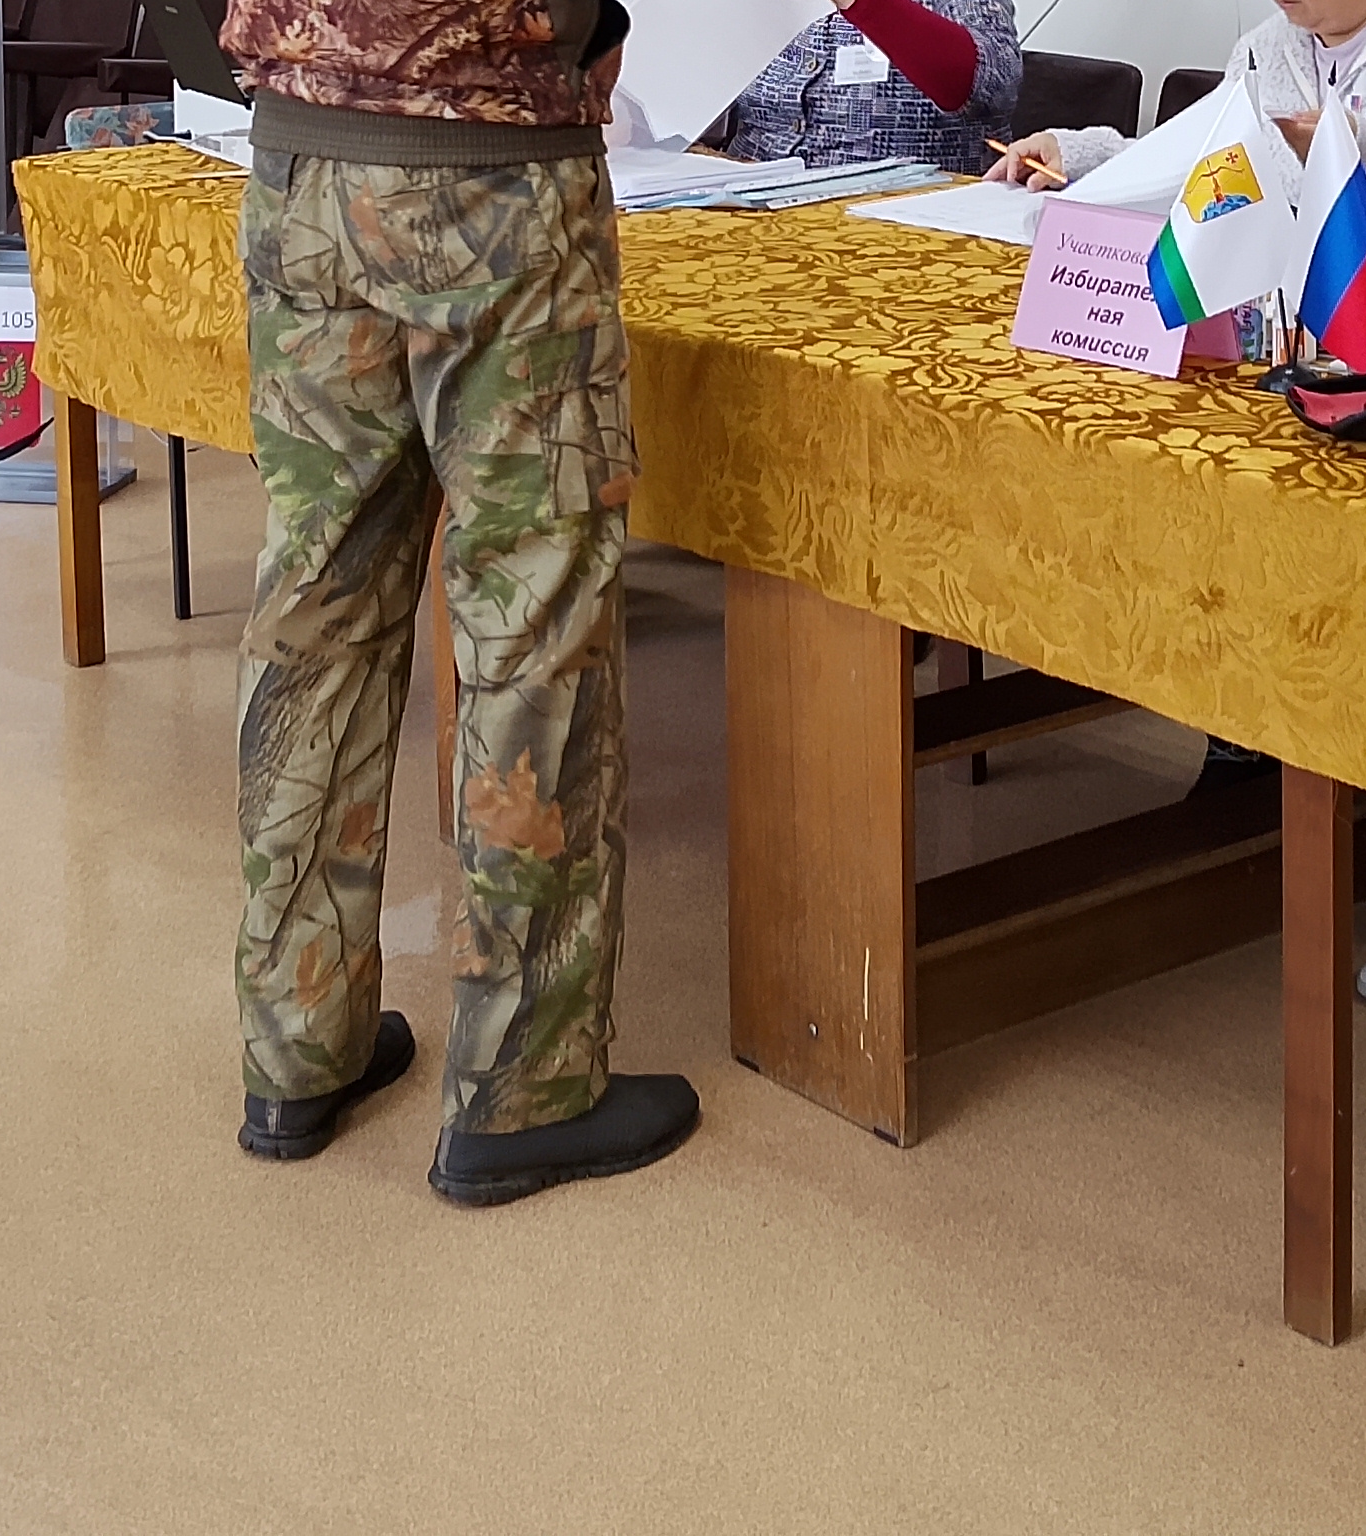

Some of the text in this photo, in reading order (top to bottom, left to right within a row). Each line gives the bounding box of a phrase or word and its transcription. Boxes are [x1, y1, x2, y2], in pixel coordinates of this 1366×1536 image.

[1056, 232, 1149, 265] Участков
[1050, 264, 1156, 302] Избирате
[1086, 306, 1125, 326] ная
[1051, 329, 1150, 362] комиссия
